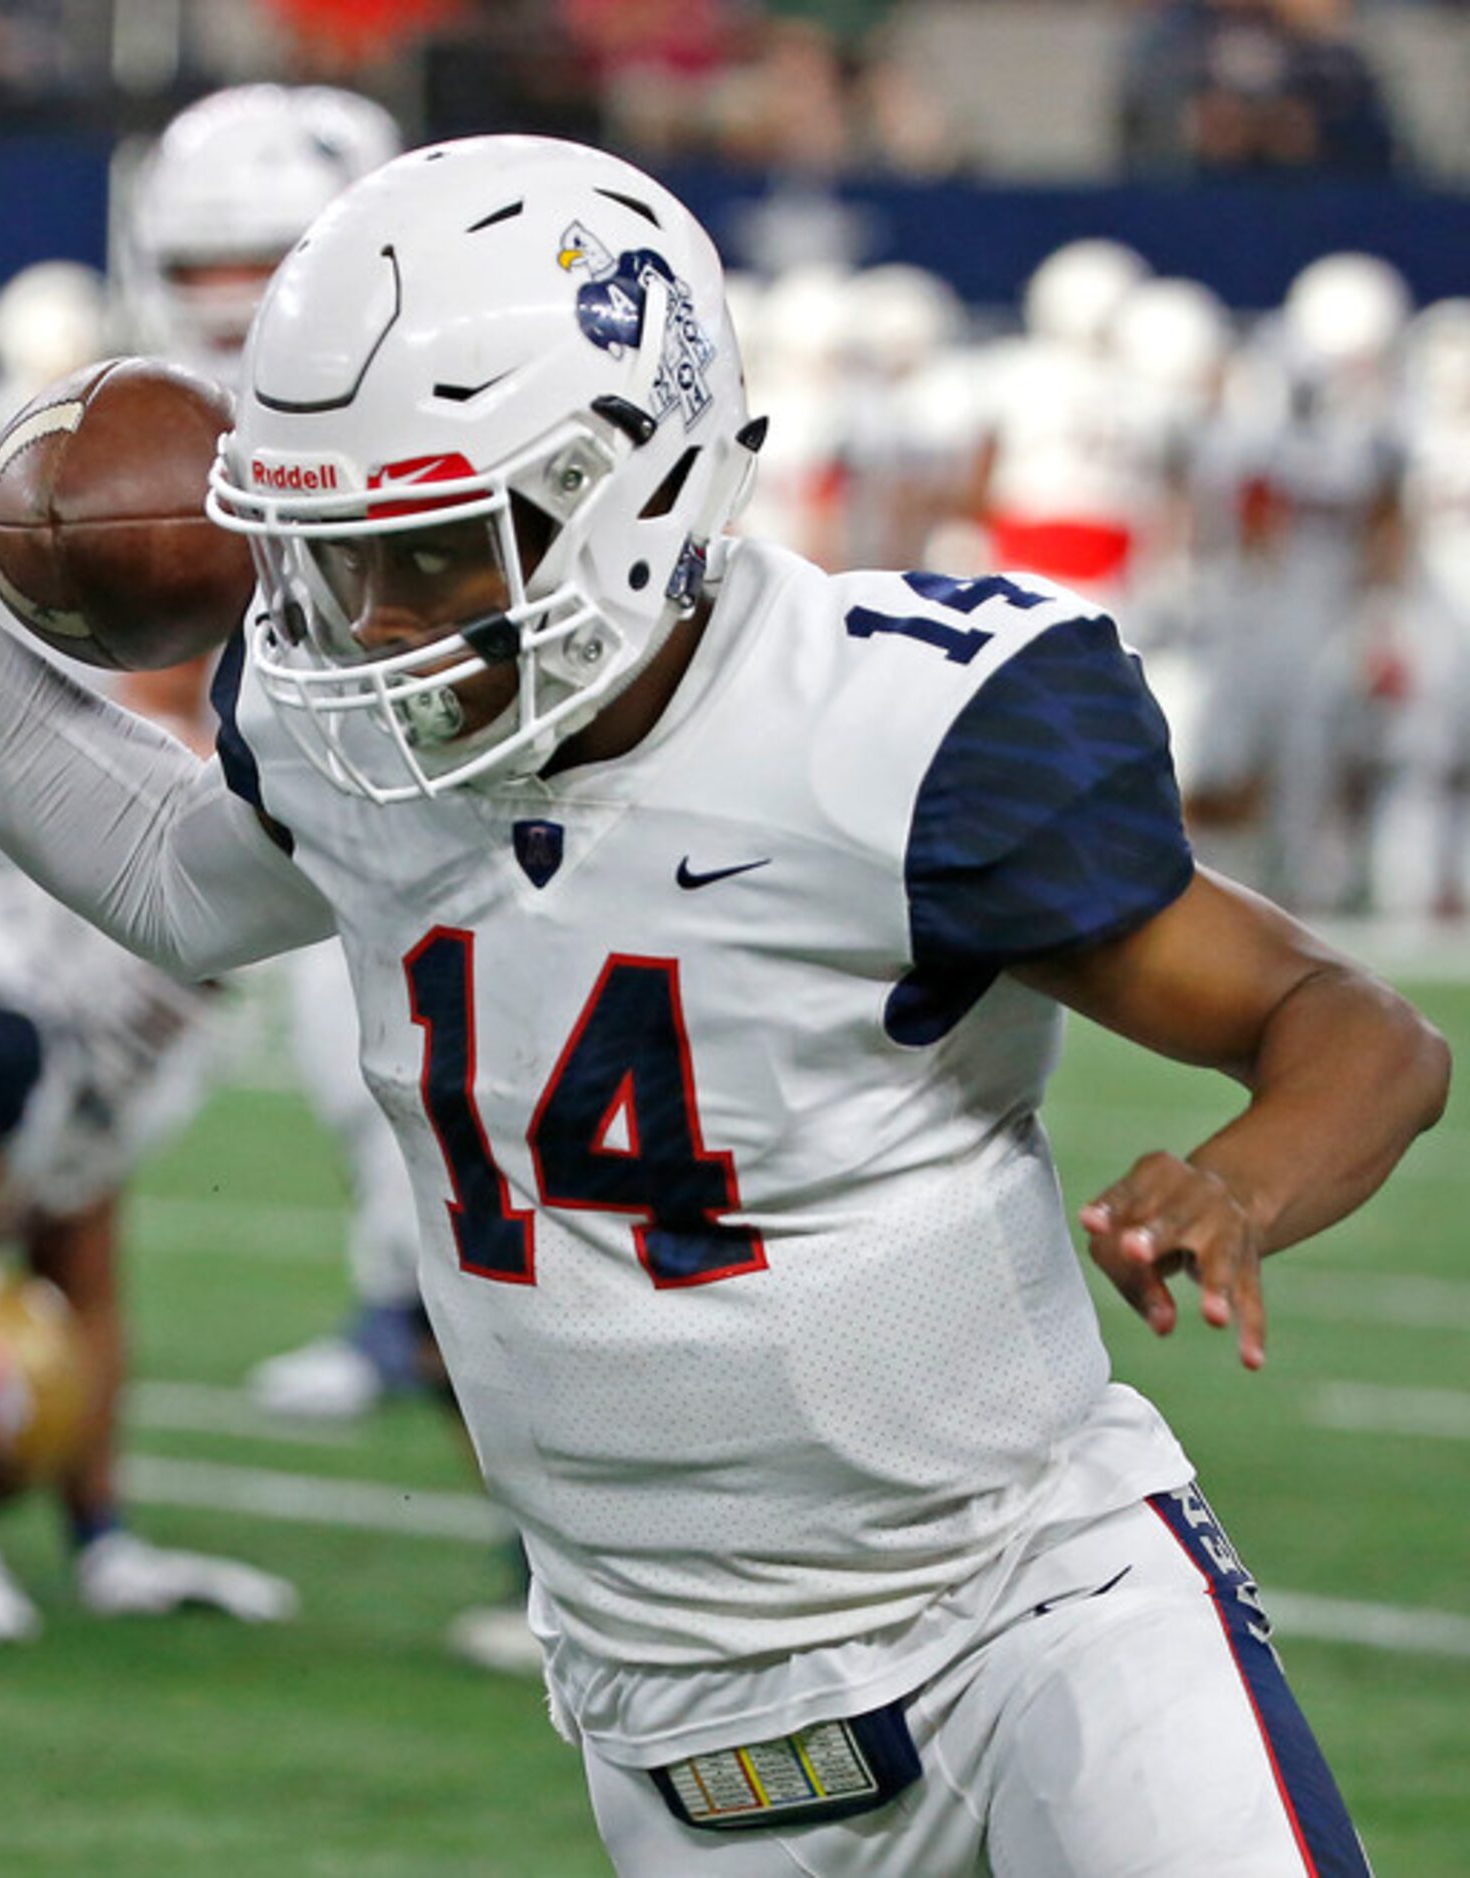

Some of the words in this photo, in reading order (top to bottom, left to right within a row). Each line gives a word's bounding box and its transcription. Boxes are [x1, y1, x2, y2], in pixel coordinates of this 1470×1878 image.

[251, 459, 338, 490] Riddell
[844, 570, 1057, 666] 14
[402, 924, 770, 1290] 14
